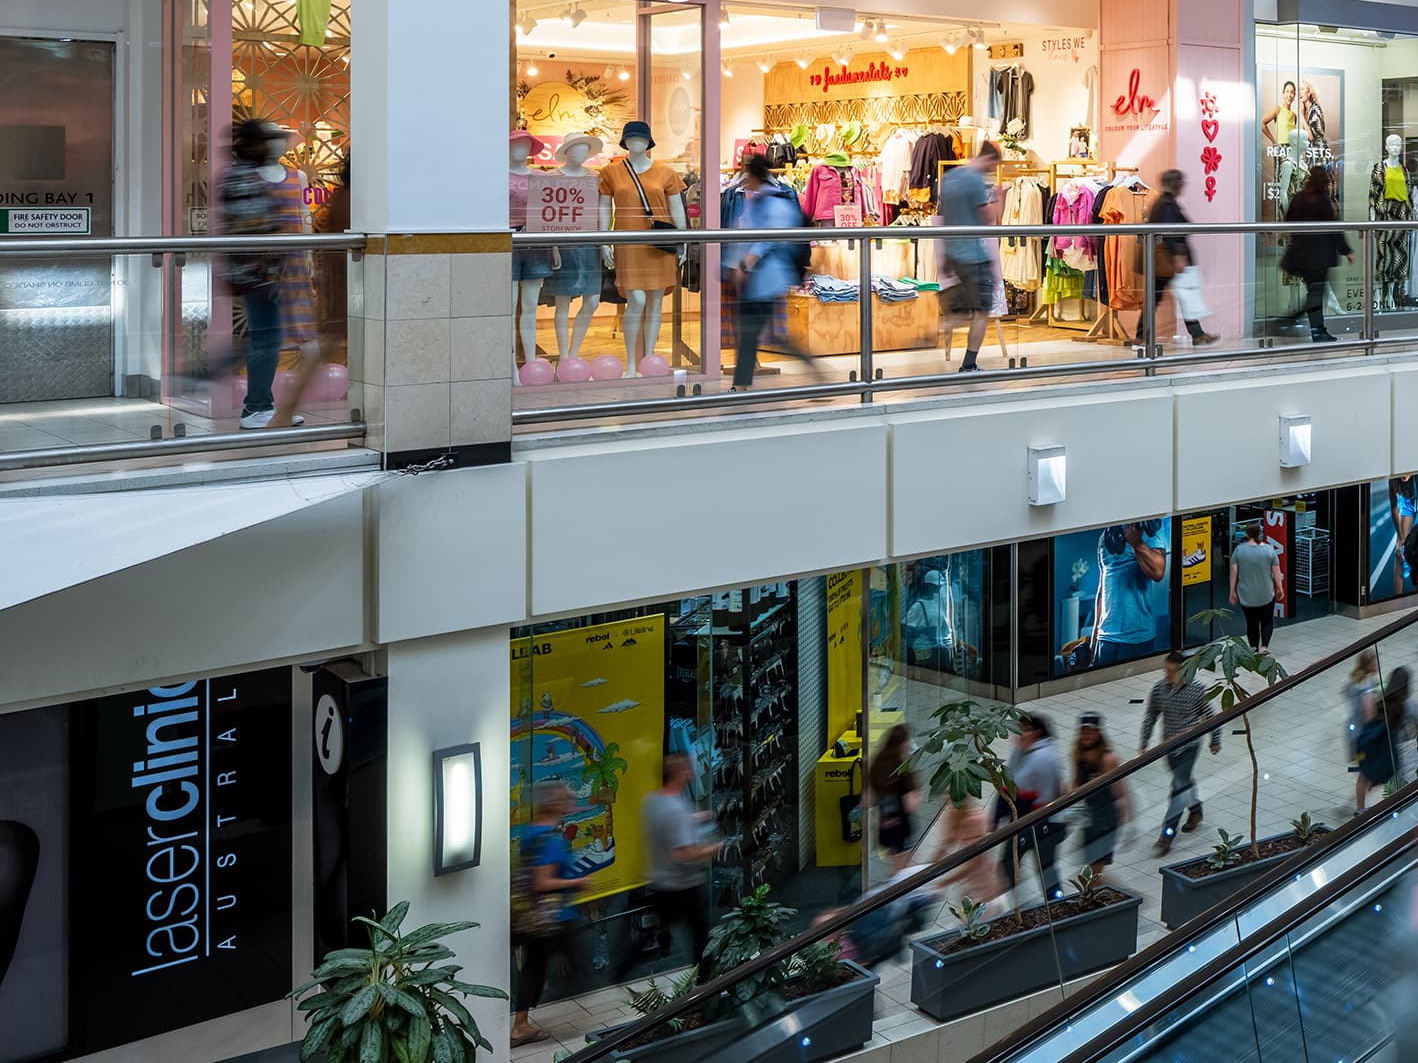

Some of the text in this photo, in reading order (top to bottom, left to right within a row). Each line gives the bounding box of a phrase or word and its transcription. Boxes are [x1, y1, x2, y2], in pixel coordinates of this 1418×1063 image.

[1042, 37, 1085, 51] STYLES WE
[1110, 69, 1161, 115] elm
[528, 93, 577, 122] elm
[1140, 123, 1168, 131] LIFESTYLE
[44, 192, 78, 204] BAY
[85, 192, 94, 204] 1
[541, 187, 585, 204] 30%
[31, 213, 58, 221] SAFETY
[60, 213, 84, 221] DOOR
[541, 206, 584, 223] OFF
[840, 214, 857, 222] 30%
[1346, 301, 1365, 312] 6-2
